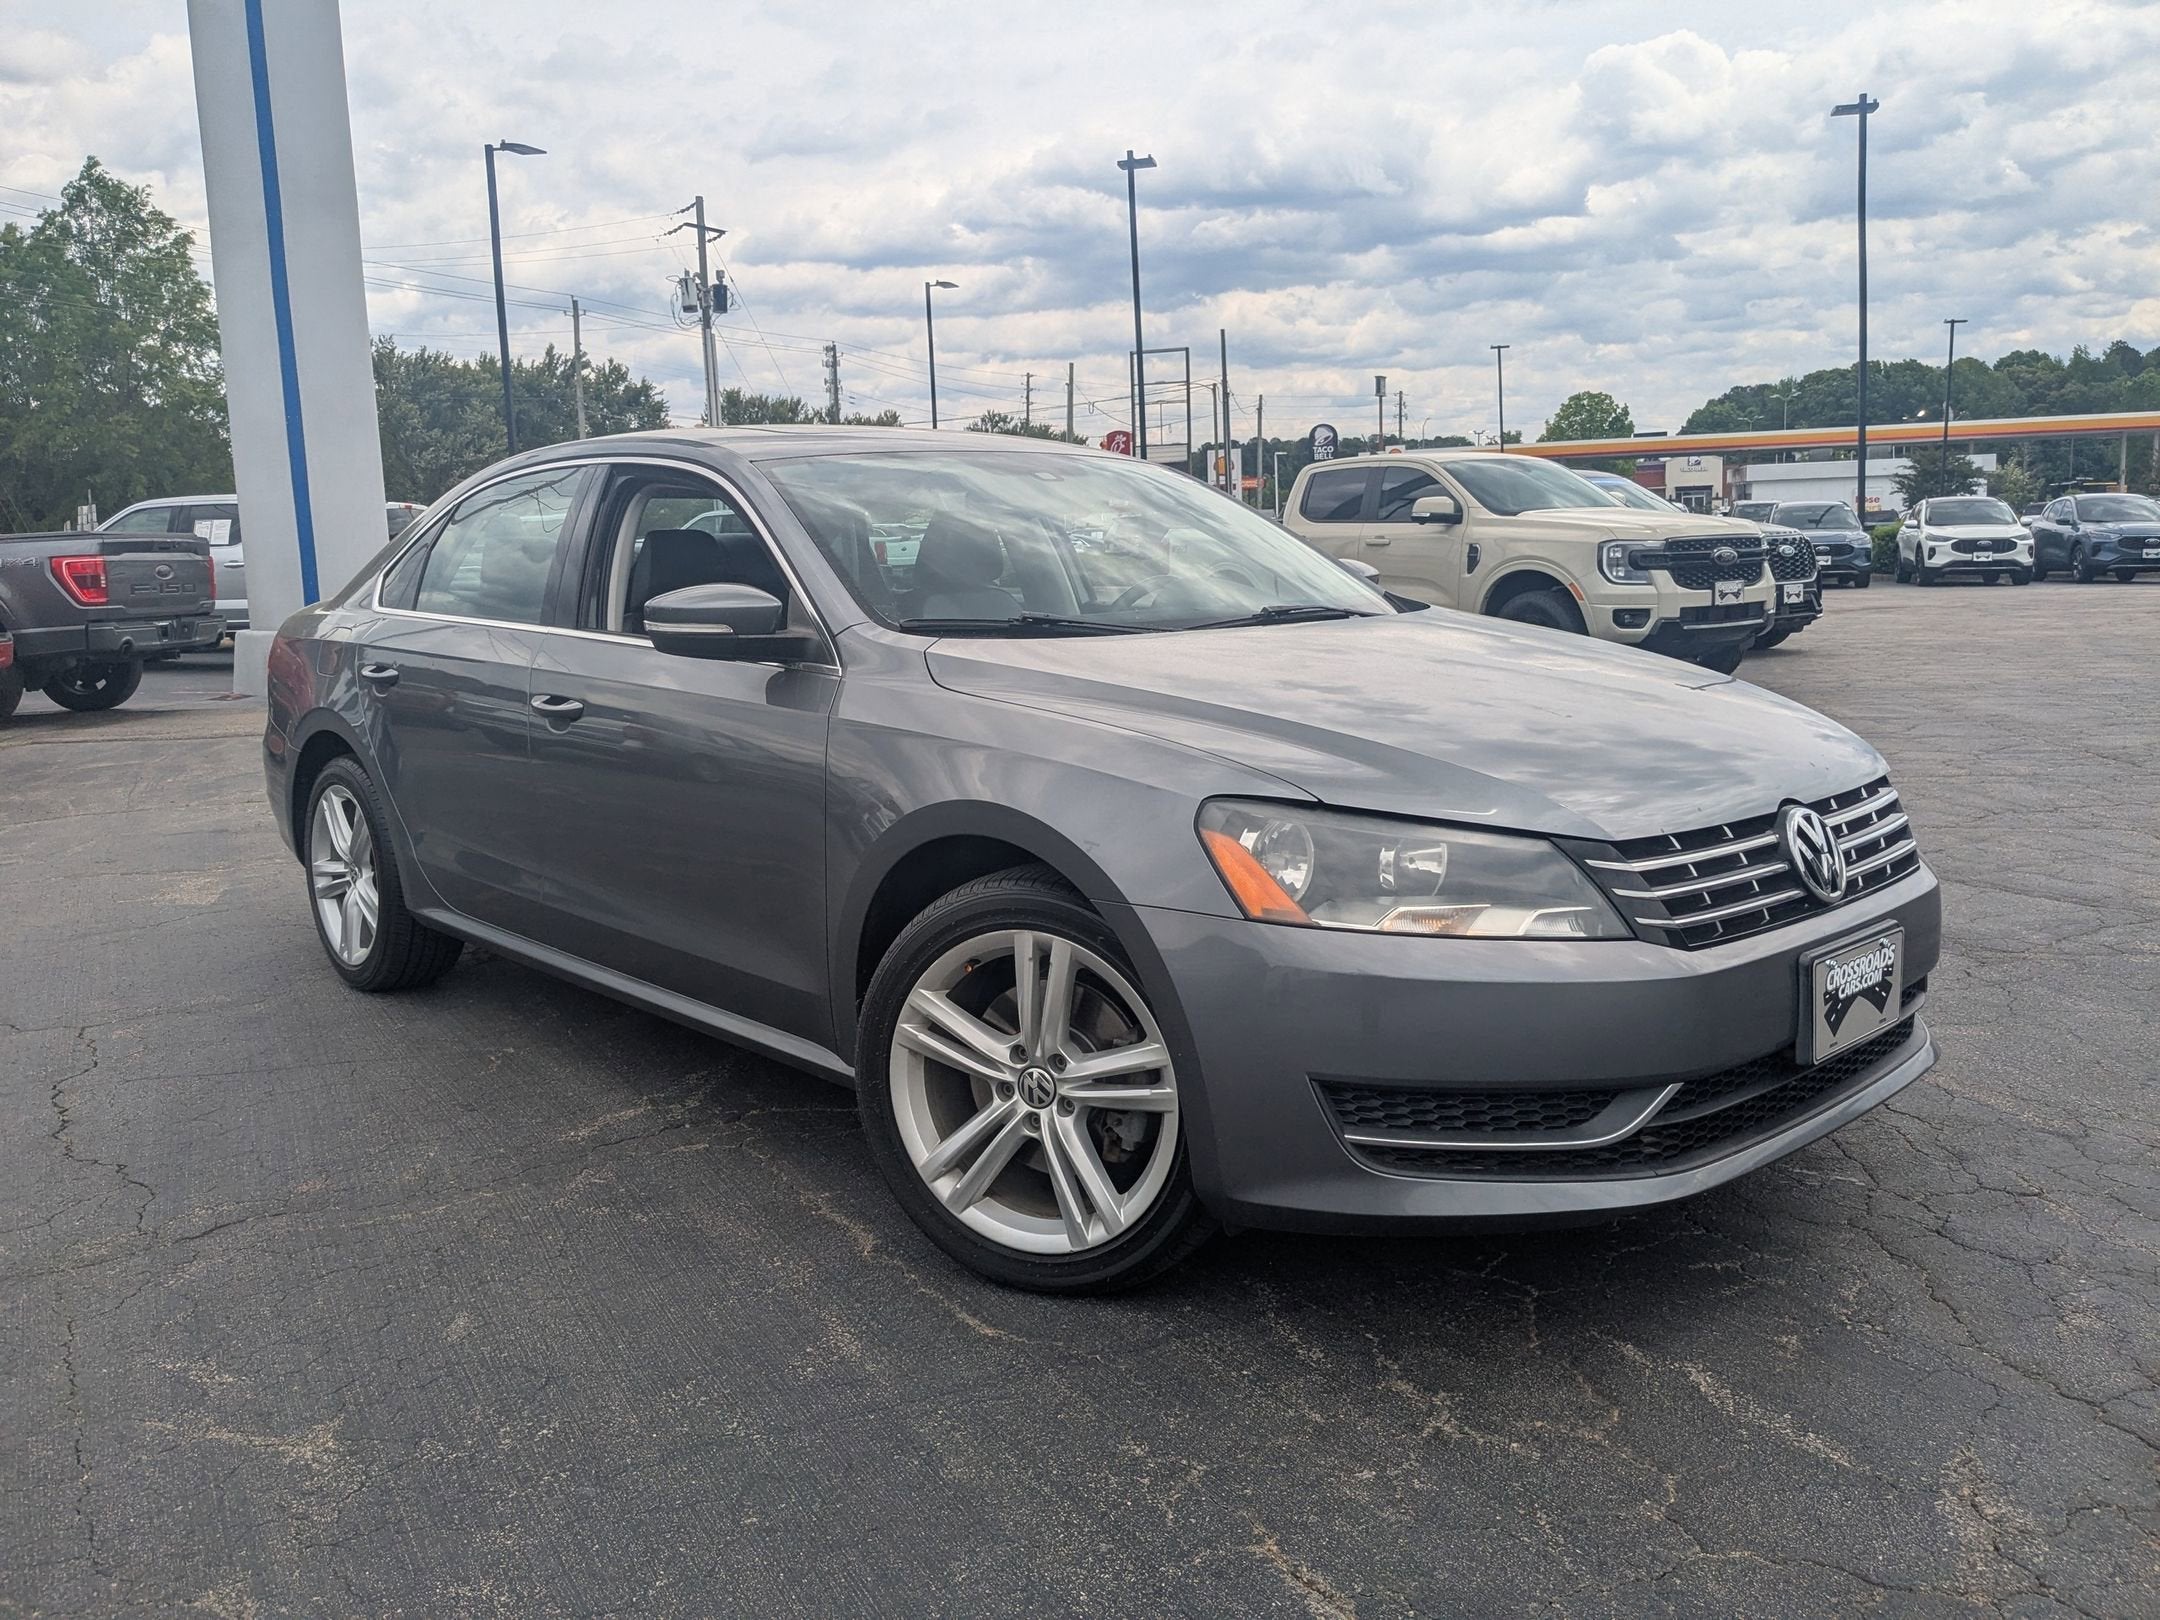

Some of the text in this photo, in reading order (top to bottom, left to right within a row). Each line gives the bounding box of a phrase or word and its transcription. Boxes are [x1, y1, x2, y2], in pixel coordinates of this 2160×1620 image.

[130, 583, 196, 596] F-150
[1827, 944, 1896, 990] CROSSROADS
[1838, 967, 1884, 999] CARS.COM
